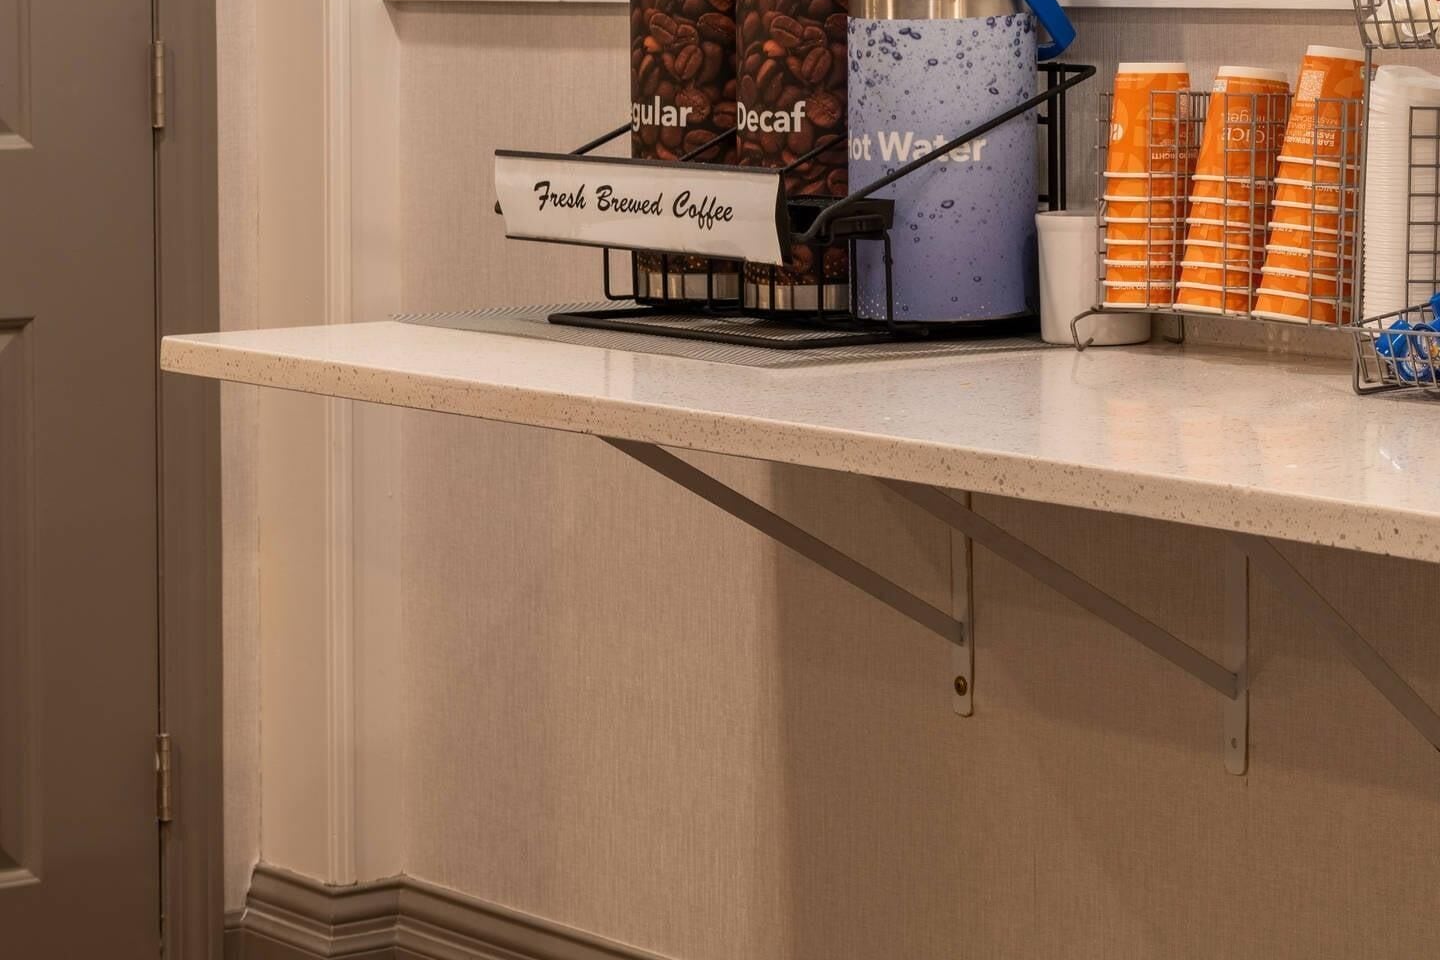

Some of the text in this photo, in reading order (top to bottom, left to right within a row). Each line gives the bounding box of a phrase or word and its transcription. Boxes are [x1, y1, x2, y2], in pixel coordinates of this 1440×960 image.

[631, 96, 693, 132] gular
[737, 101, 806, 133] Decaf
[877, 130, 987, 162] Water
[1222, 127, 1285, 148] COICE
[534, 181, 733, 230] Fresh Brewed Coffee
